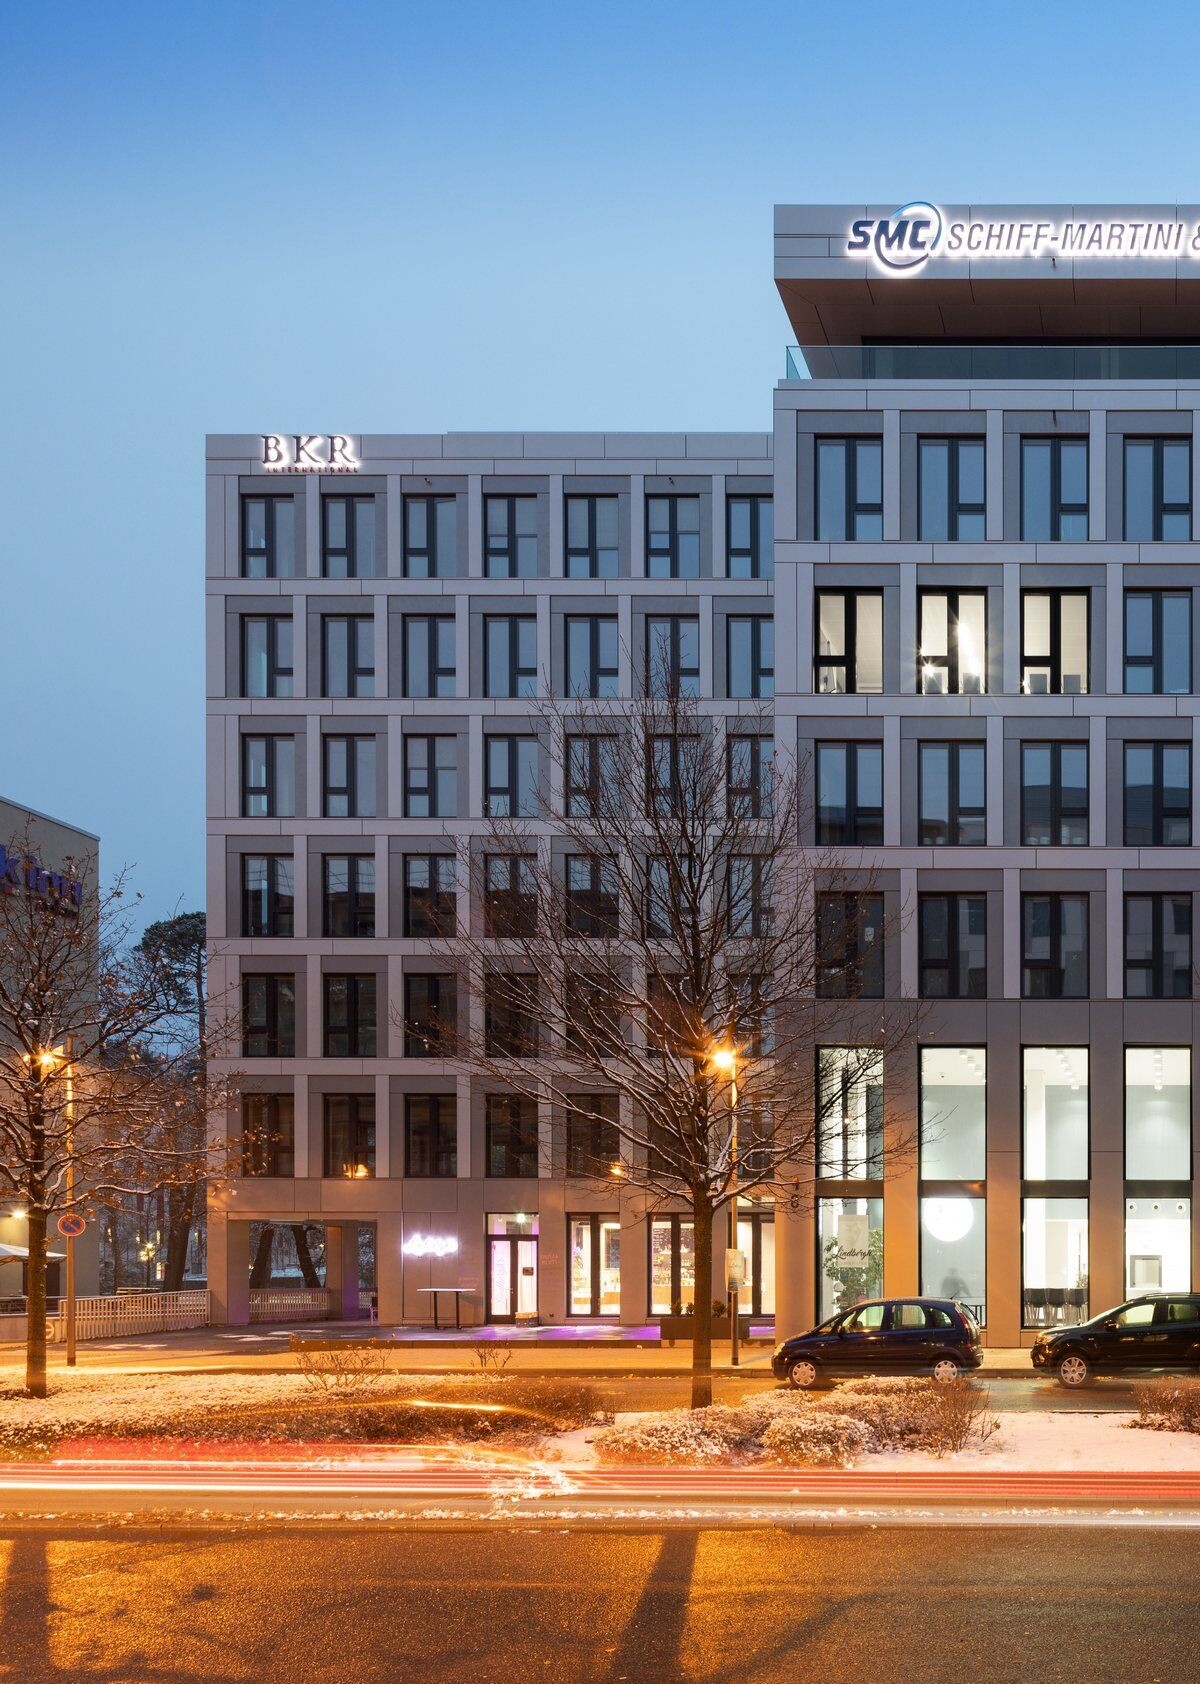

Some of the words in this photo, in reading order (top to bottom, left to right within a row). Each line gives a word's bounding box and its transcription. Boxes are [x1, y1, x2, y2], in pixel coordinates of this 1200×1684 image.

[847, 219, 933, 251] SMC
[947, 222, 1184, 251] SCHIFF-MARTINI
[261, 435, 356, 465] BKR
[831, 1245, 873, 1260] Lindbergh
